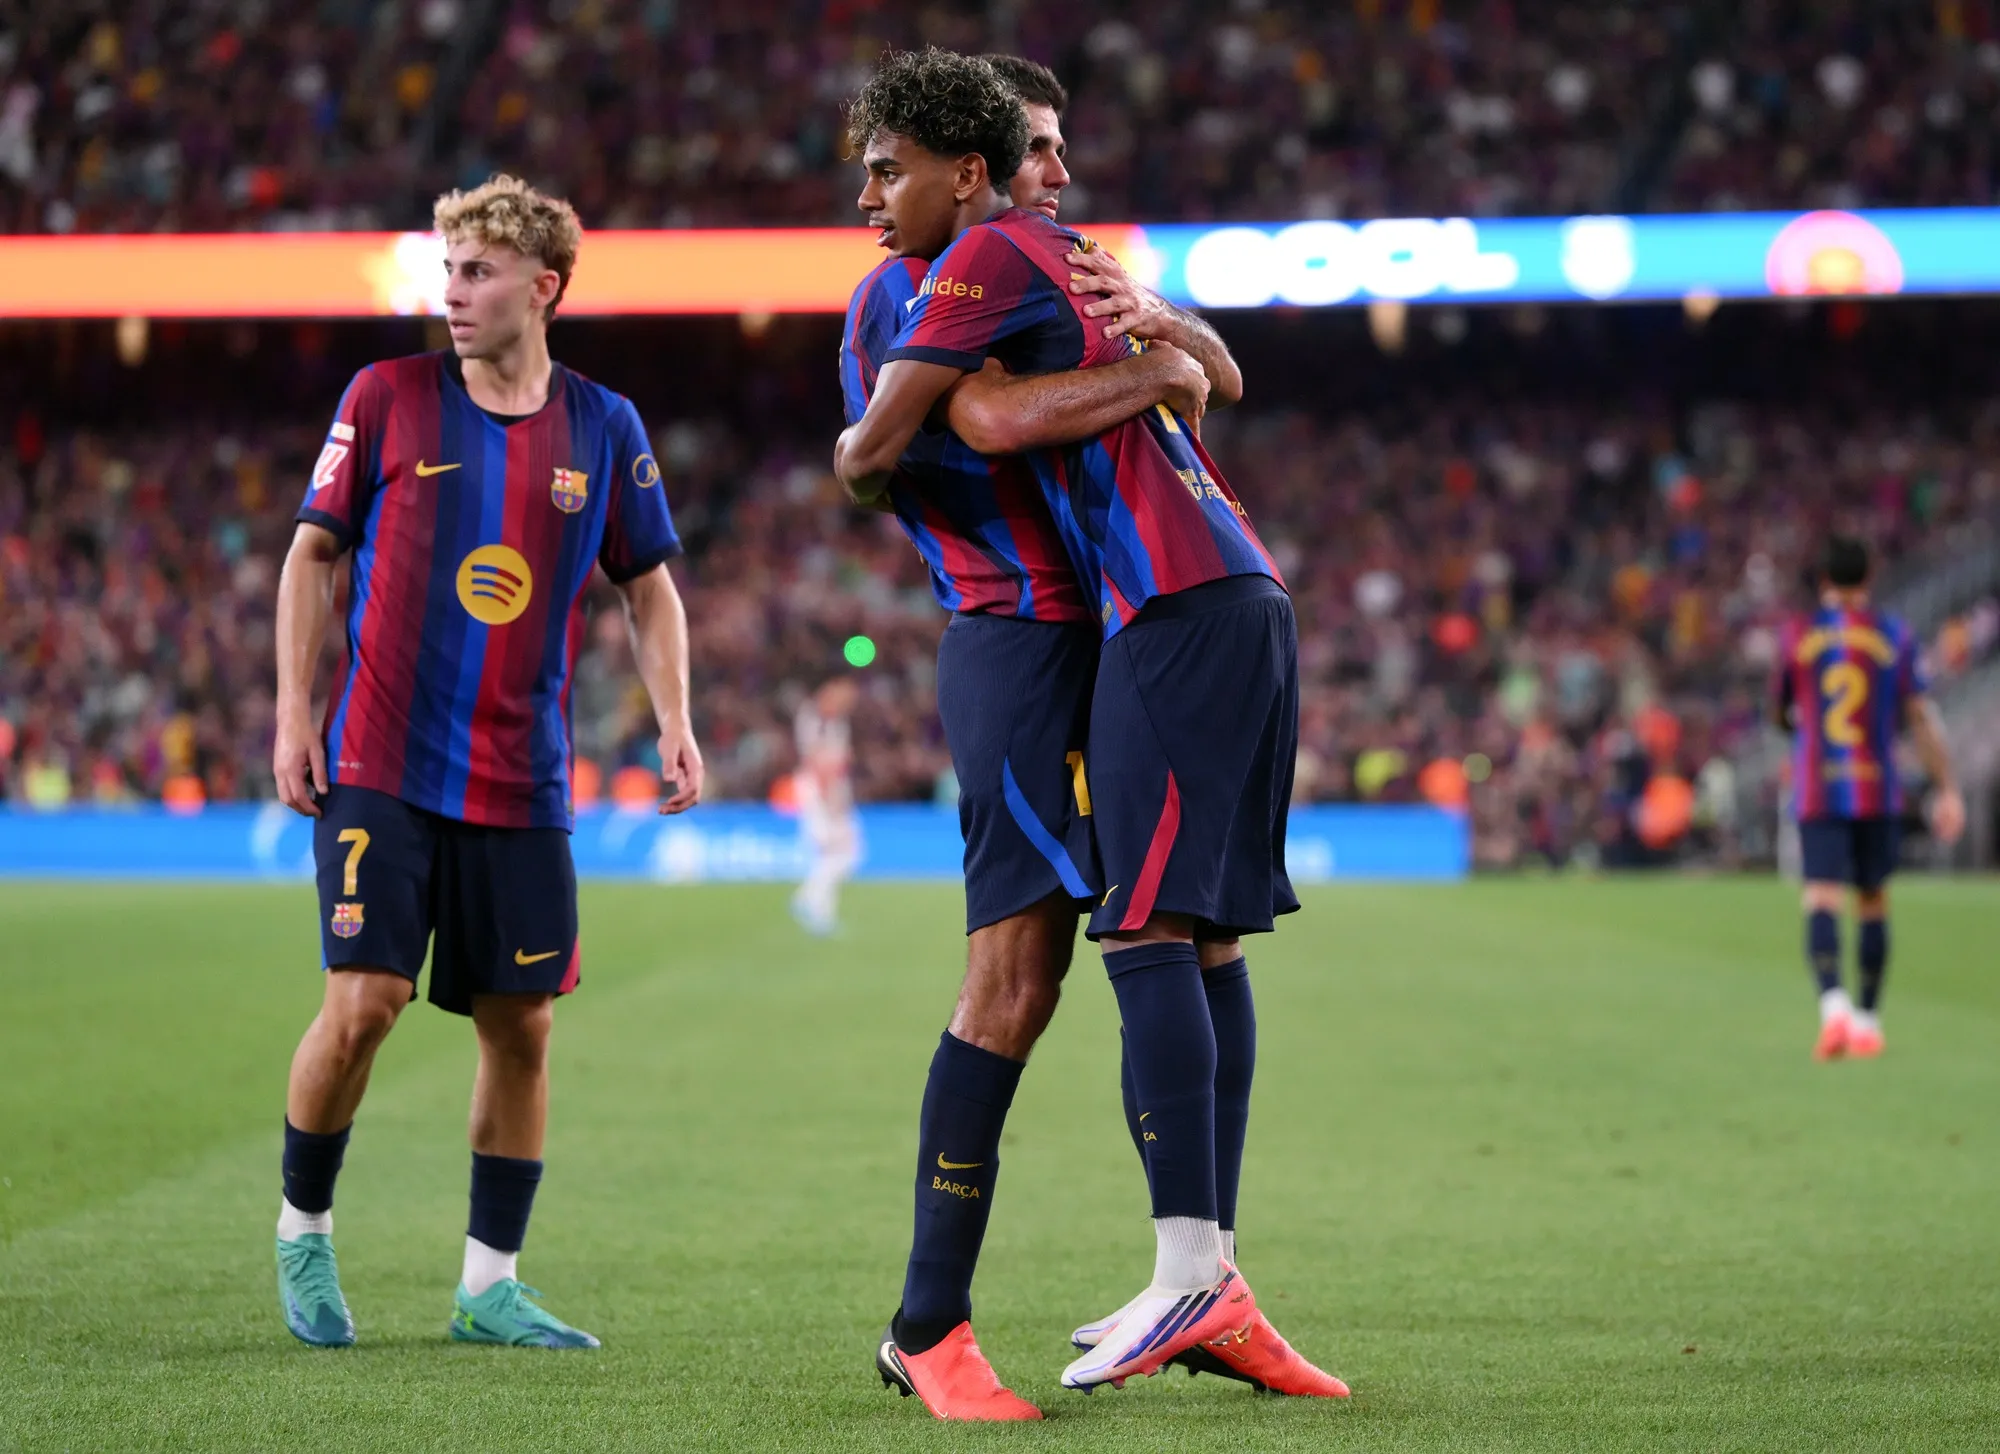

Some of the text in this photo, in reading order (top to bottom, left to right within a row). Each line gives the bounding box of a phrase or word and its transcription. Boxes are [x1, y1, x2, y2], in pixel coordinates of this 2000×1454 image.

[1820, 661, 1869, 747] 2
[337, 828, 371, 896] 7
[931, 1175, 980, 1199] BARÇA
